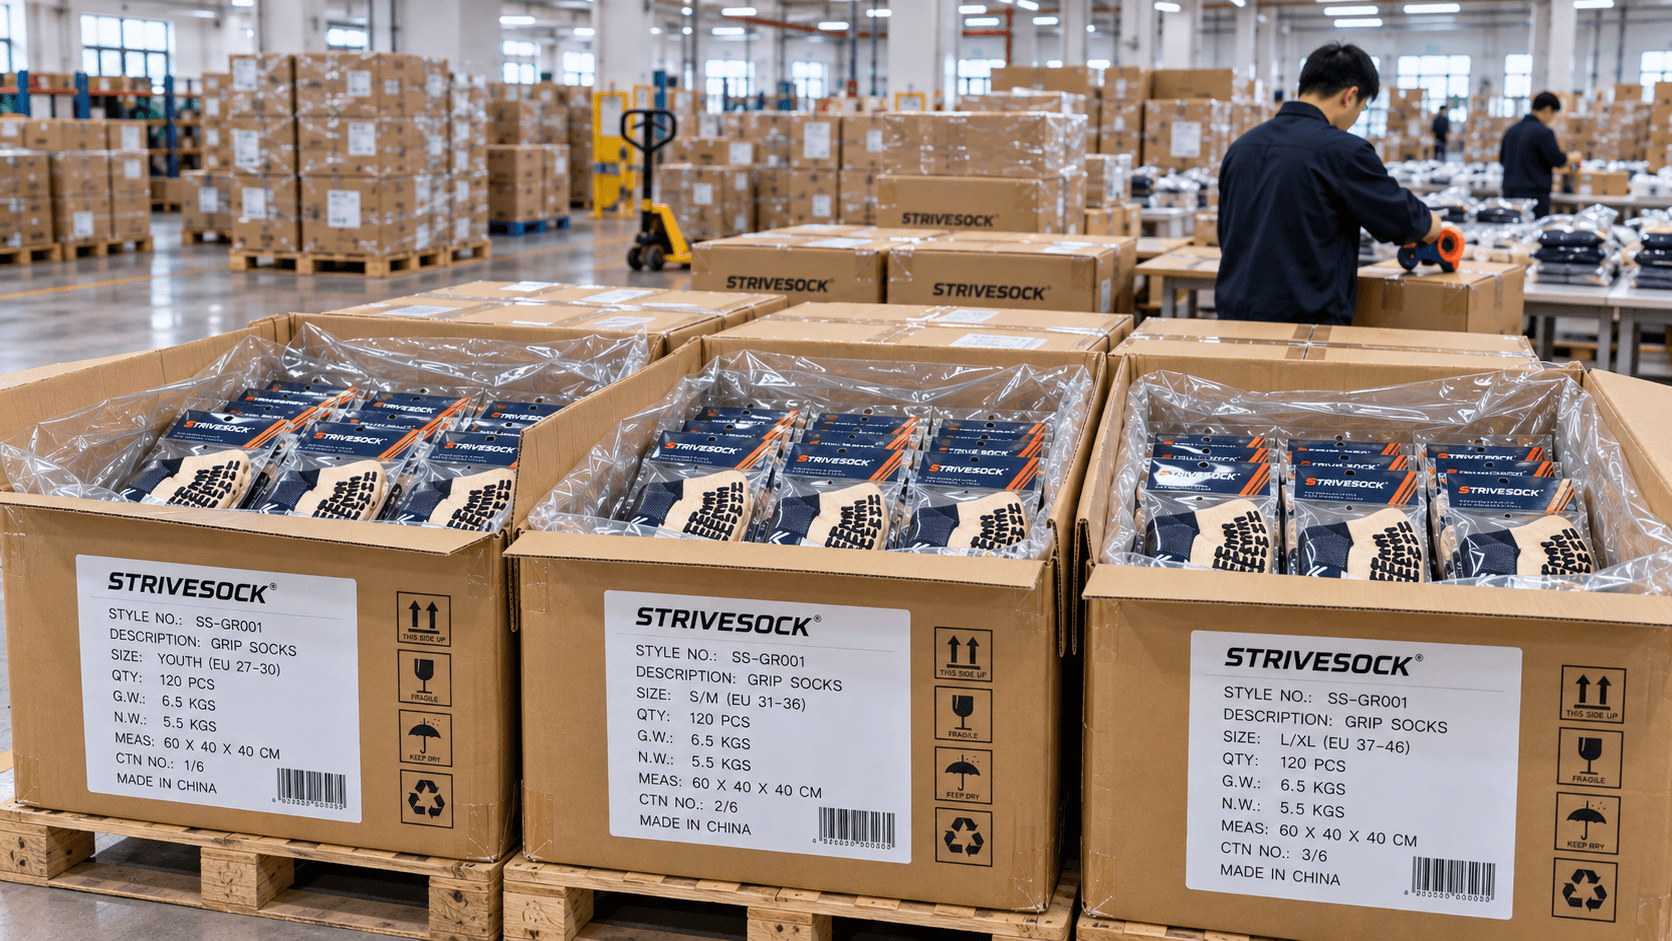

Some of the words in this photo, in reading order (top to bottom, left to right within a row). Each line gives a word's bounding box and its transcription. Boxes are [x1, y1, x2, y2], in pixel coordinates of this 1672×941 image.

[902, 212, 994, 228] STRIVESOCK
[726, 275, 828, 293] STRIVESOCK
[933, 282, 1045, 301] STRIVESOCK
[184, 420, 252, 434] STRIVESOCK
[314, 432, 384, 445] STRIVESOCK
[444, 441, 515, 454] STRIVESOCK
[665, 441, 740, 455] STRIVESOCK
[797, 454, 871, 467] STRIVESOCK
[929, 463, 1004, 476] STRIVESOCK
[1305, 477, 1385, 489] STRIVESOCK
[1458, 485, 1539, 497] STRIVESOCK
[109, 608, 149, 623] STYLE
[156, 613, 182, 625] NO.:
[196, 616, 262, 633] SS-GR001
[110, 628, 200, 647] DESCRIPTION:
[211, 638, 242, 651] GRIP
[250, 642, 297, 657] SOCKS
[112, 649, 142, 662] SIZE:
[158, 653, 202, 668] YOUTH
[209, 657, 230, 671] (EU
[237, 661, 280, 677] 27-30)
[636, 645, 680, 659] STYLE
[688, 648, 717, 661] NO.:
[732, 651, 804, 667] SS-GR001
[112, 670, 142, 683] QTY:
[160, 674, 182, 687] 120
[189, 677, 215, 690] PCS
[637, 666, 736, 684] DESCRIPTION:
[748, 674, 782, 687] GRIP
[791, 677, 842, 692] SOCKS
[113, 690, 145, 704] G.W.:
[162, 695, 183, 708] 6.5
[190, 698, 216, 711] KGS
[637, 687, 671, 701] SIZE:
[690, 691, 718, 704] S/M
[727, 692, 750, 707] (EU
[759, 696, 806, 712] 31-36)
[1224, 686, 1272, 701] STYLE
[1281, 690, 1312, 703] NO.:
[1328, 692, 1407, 709] SS-GR001
[114, 712, 146, 725] N.W.:
[164, 716, 183, 729] 5.5
[190, 719, 217, 732] KGS
[637, 708, 670, 722] QTY:
[690, 712, 714, 725] 120
[722, 715, 750, 728] PCS
[1224, 708, 1332, 727] DESCRIPTION:
[1345, 716, 1383, 729] GRIP
[1391, 718, 1448, 734] SOCKS
[1606, 712, 1618, 720] UP
[116, 732, 154, 747] MEAS:
[164, 737, 179, 749] 60
[186, 739, 194, 751] X
[201, 741, 217, 753] 40
[223, 743, 232, 755] X
[238, 746, 254, 757] 40
[260, 747, 280, 760] CM
[638, 730, 673, 744] G.W.:
[692, 734, 714, 747] 6.5
[722, 737, 751, 750] KGS
[1224, 730, 1260, 744] SIZE:
[1281, 734, 1316, 748] L/XL
[1324, 735, 1349, 750] (EU
[1357, 739, 1410, 755] 37-46)
[116, 752, 142, 766] CTN
[148, 756, 173, 769] NO.:
[185, 760, 204, 772] 1/6
[639, 751, 673, 765] N.W.:
[692, 756, 714, 769] 5.5
[722, 758, 751, 772] KGS
[1223, 752, 1258, 766] QTY:
[1281, 756, 1306, 769] 120
[1315, 758, 1346, 773] PCS
[118, 773, 153, 787] MADE
[160, 778, 171, 789] IN
[178, 780, 217, 794] CHINA
[639, 772, 682, 787] MEAS:
[693, 777, 710, 789] 60
[717, 779, 726, 791] X
[734, 781, 751, 793] 40
[758, 783, 768, 794] X
[775, 784, 793, 796] 40
[800, 786, 822, 799] CM
[1222, 775, 1260, 789] G.W.:
[1281, 779, 1305, 793] 6.5
[1314, 782, 1346, 795] KGS
[640, 794, 668, 807] CTN
[675, 797, 703, 810] NO.:
[715, 800, 738, 813] 2/6
[1222, 798, 1260, 812] N.W.:
[1280, 802, 1305, 815] 5.5
[1313, 804, 1345, 818] KGS
[640, 814, 680, 829] MADE
[687, 819, 700, 831] IN
[707, 821, 751, 835] CHINA
[1222, 820, 1268, 835] MEAS:
[1280, 824, 1298, 837] 60
[1306, 826, 1315, 839] X
[1323, 828, 1342, 841] 40
[1349, 830, 1359, 842] X
[1367, 832, 1386, 845] 40
[1393, 834, 1417, 847] CM
[1221, 842, 1252, 855] CTN
[1260, 845, 1289, 859] NO.:
[1302, 849, 1327, 862] 3/6
[1221, 864, 1264, 879] MADE
[1272, 868, 1285, 881] IN
[1293, 870, 1341, 886] CHINA
